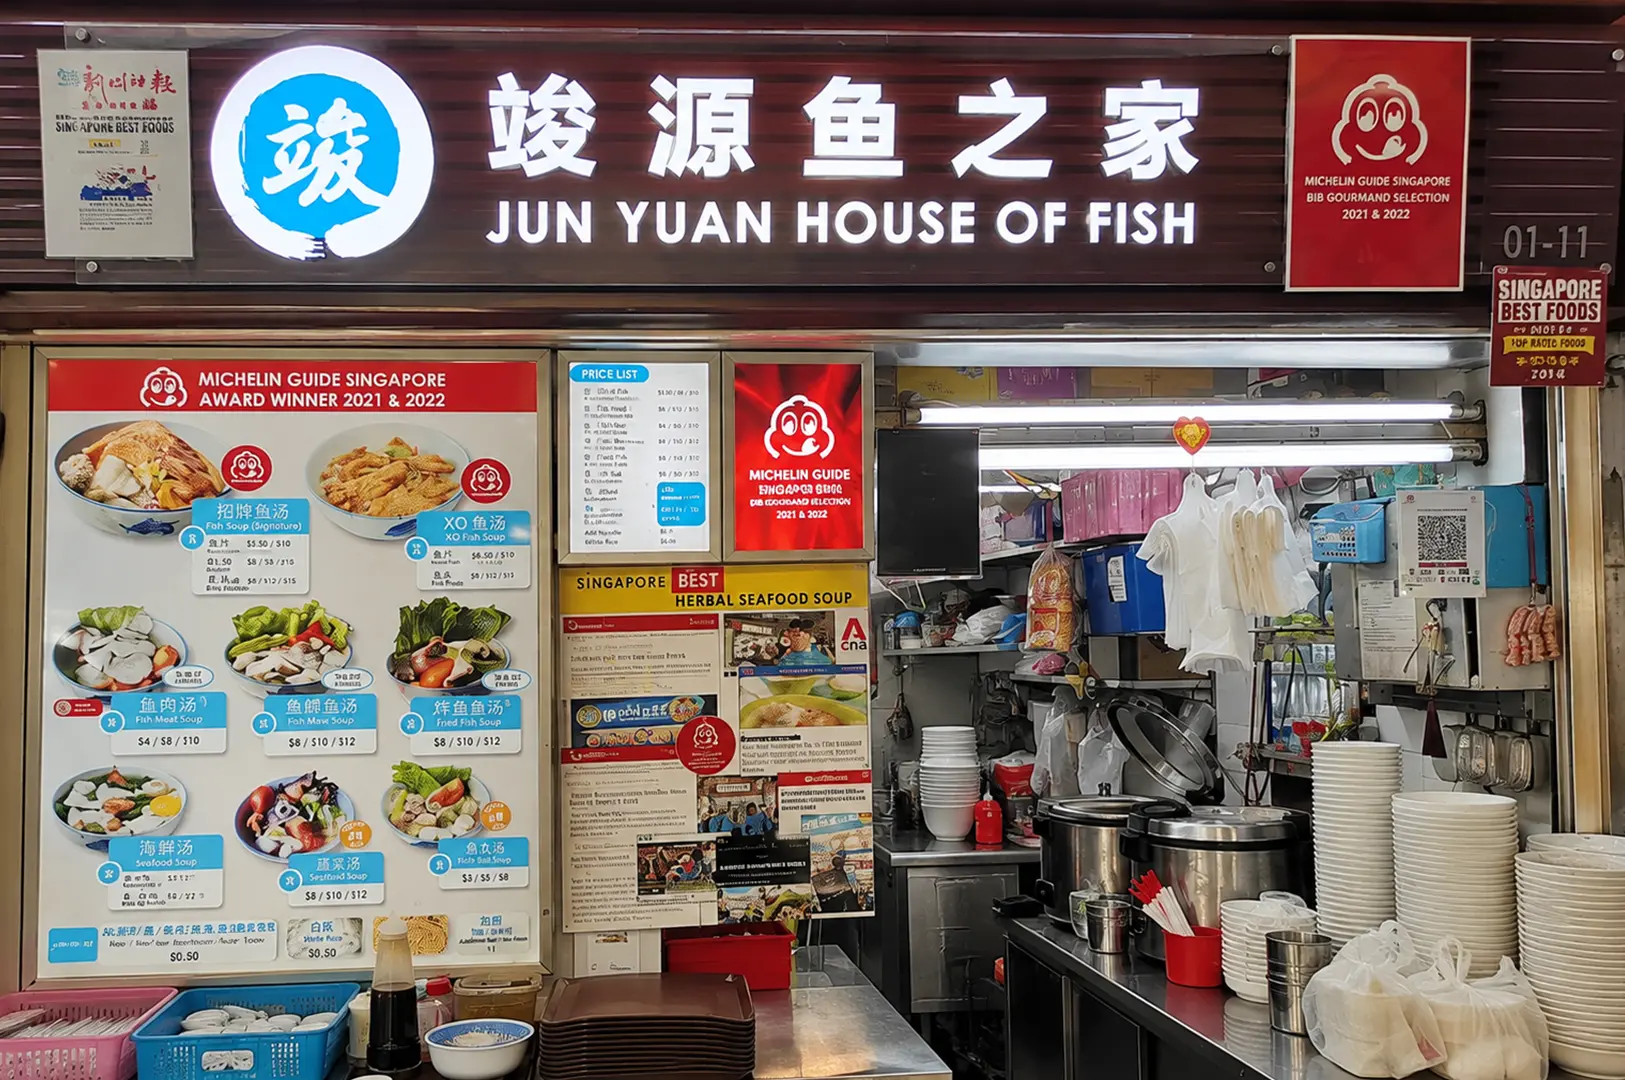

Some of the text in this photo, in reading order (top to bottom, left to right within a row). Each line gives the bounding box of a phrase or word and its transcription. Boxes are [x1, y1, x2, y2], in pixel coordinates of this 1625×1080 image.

[115, 121, 139, 133] BEST
[142, 121, 175, 133] FOODS
[488, 72, 1199, 180] 竣源鱼之家
[262, 97, 388, 208] 竣
[1304, 176, 1451, 187] MICHELIN GUIDE SINGAPORE
[1306, 193, 1450, 203] BIB GOURMAND SELECTION
[1342, 209, 1411, 219] 2021 & 2022
[485, 200, 1195, 244] JUN YUAN HOUSE OF FISH
[1503, 224, 1588, 259] 01-11
[1498, 279, 1602, 300] SINGAPORE
[1501, 302, 1599, 321] BEST FOODS
[198, 372, 446, 387] MICHELIN GUIDE SINGAPORE
[582, 369, 639, 379] PRICE LIST
[198, 393, 446, 407] AWARD WINNER 2021 & 2022
[749, 469, 851, 480] MICHELIN GUIDE
[217, 503, 289, 519] 招牌鱼汤
[776, 510, 796, 518] 2021
[807, 510, 828, 518] 2022
[226, 522, 249, 532] Soup
[443, 515, 506, 531] XO 鱼汤
[445, 533, 460, 541] XO
[483, 533, 506, 543] Soup
[577, 572, 719, 589] SINGAPORE BEST
[675, 592, 853, 607] HERBAL SEAFOOD SOUP
[841, 640, 867, 651] cna
[135, 716, 153, 724] Fish
[180, 715, 203, 725] Soup
[307, 717, 329, 725] Maw
[331, 716, 355, 726] Soup
[479, 717, 502, 727] Soup
[135, 858, 198, 868] Seafood Soup
[347, 872, 368, 882] Soup
[170, 951, 199, 962] $0.50
[308, 948, 337, 958] $0.50
